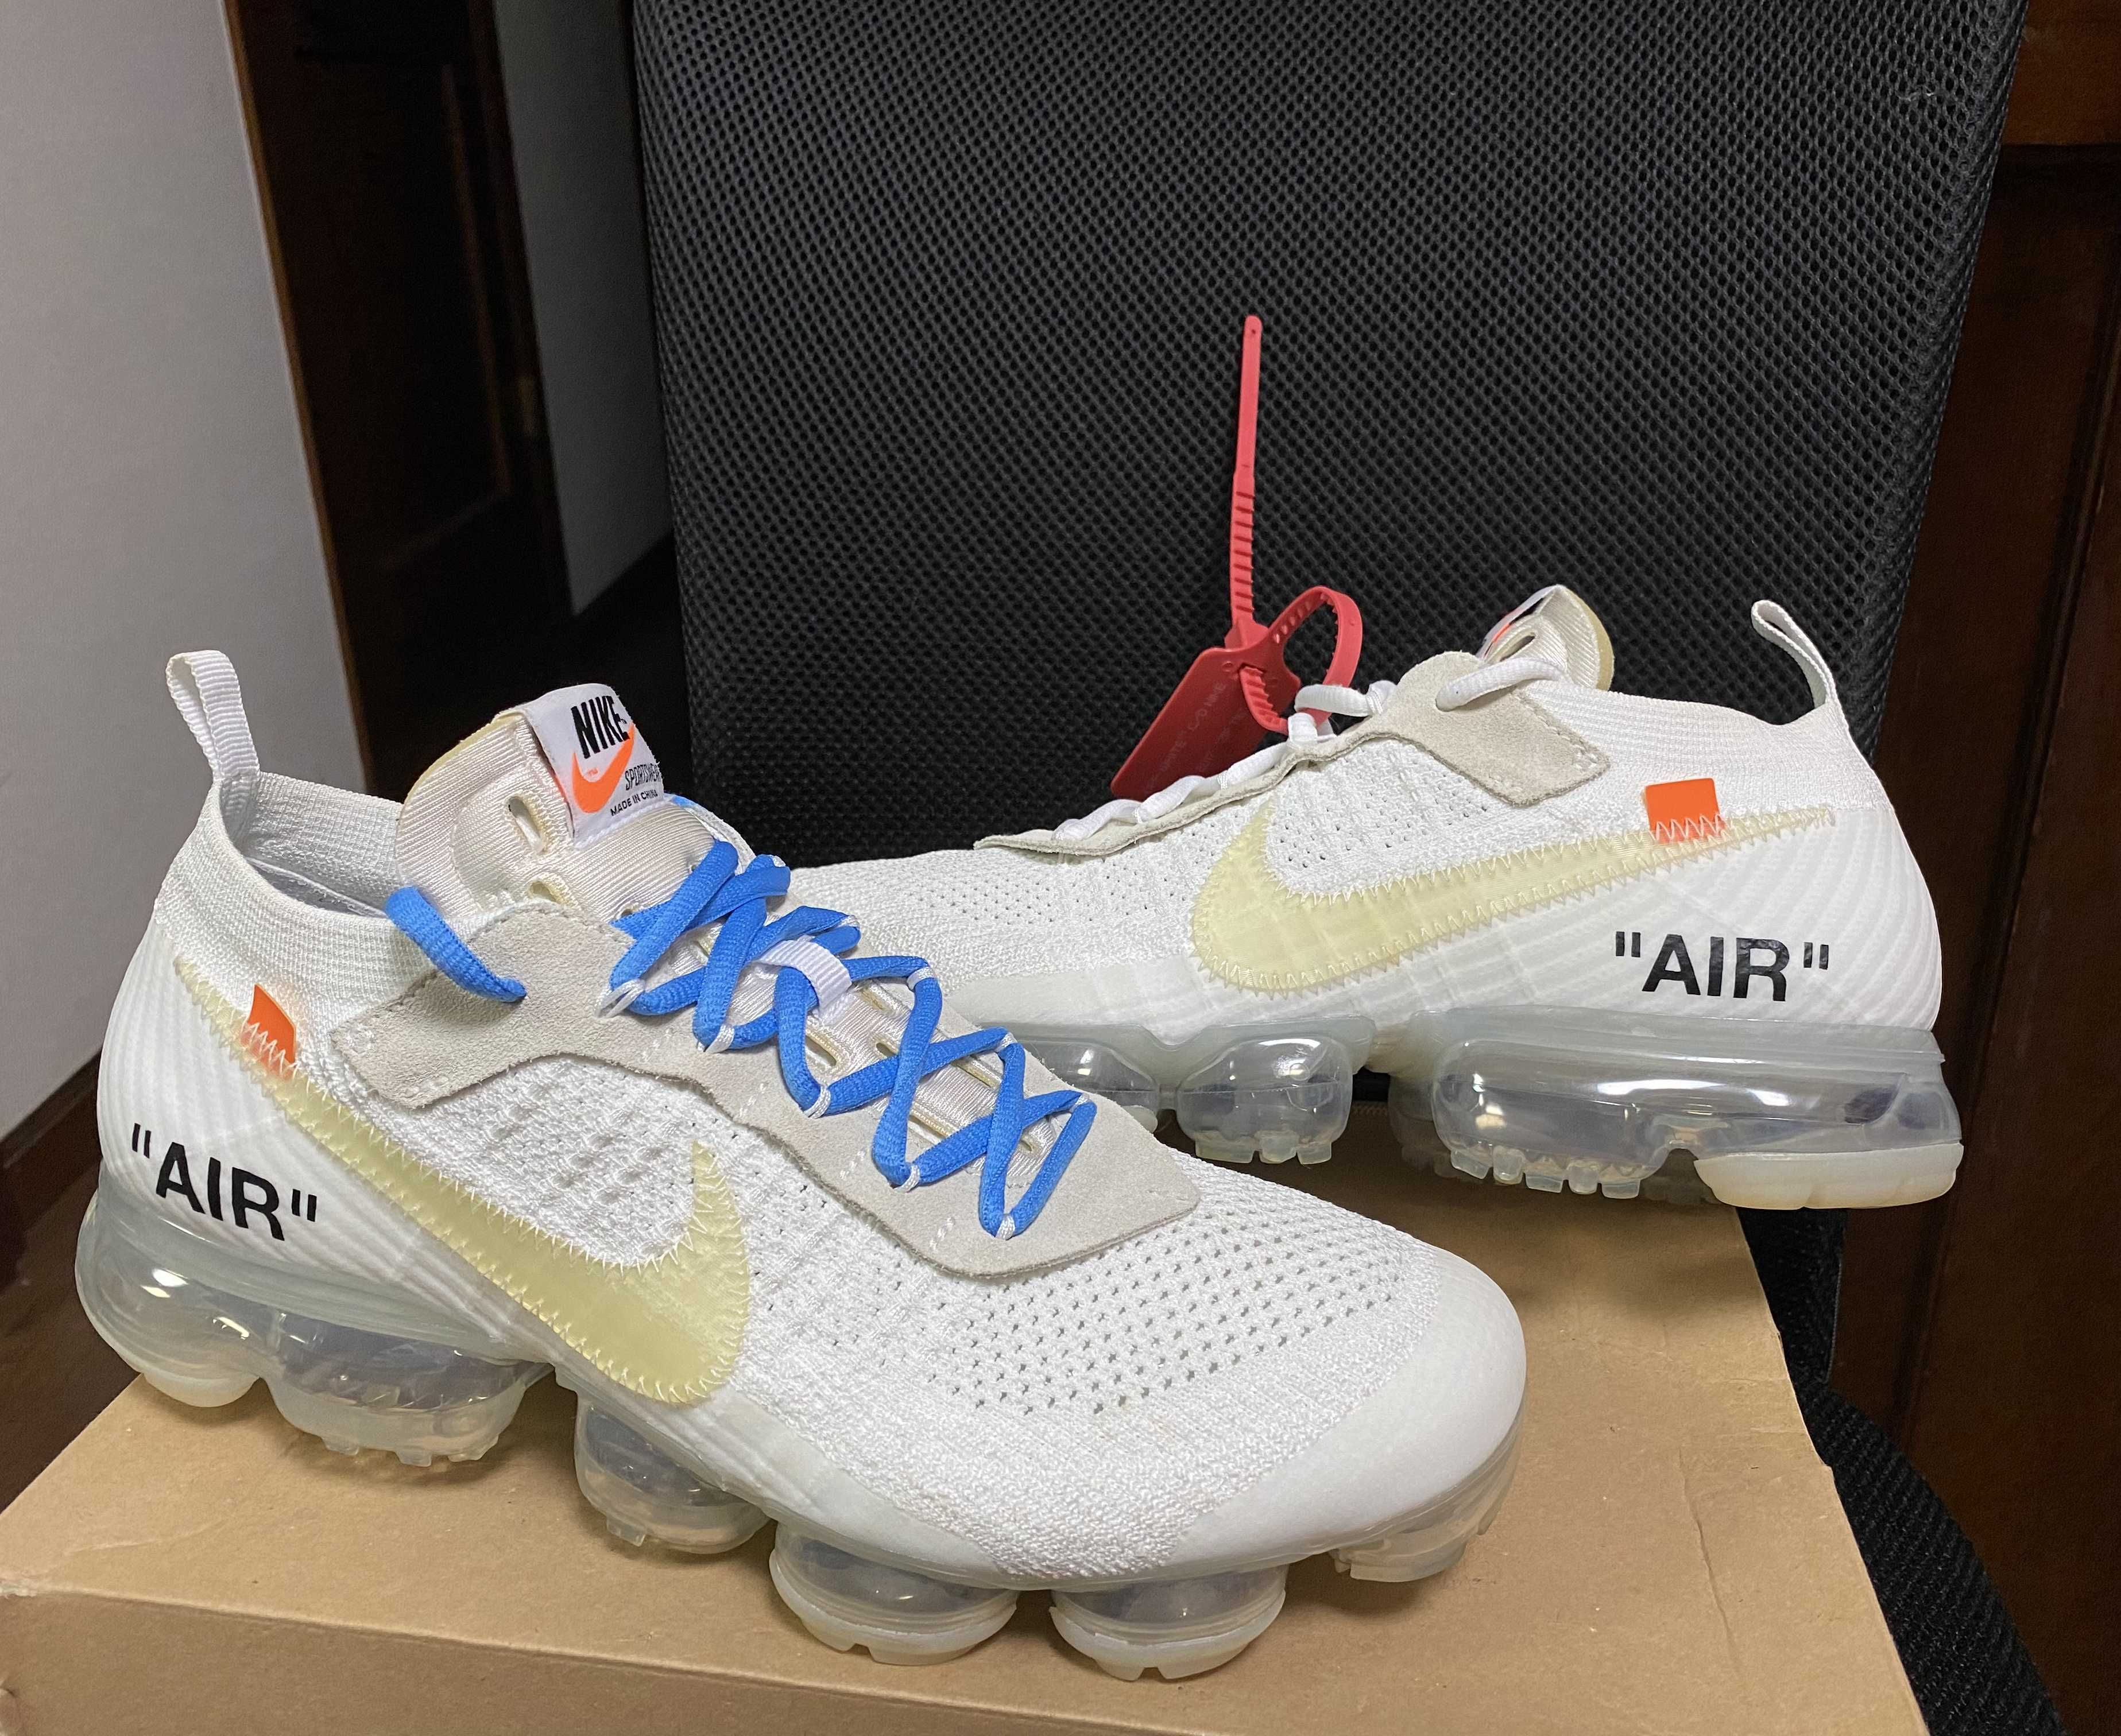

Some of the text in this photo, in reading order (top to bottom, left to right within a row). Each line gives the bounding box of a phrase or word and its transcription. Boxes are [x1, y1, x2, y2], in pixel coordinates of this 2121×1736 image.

[571, 695, 630, 759] NIKE
[610, 799, 632, 816] MADE
[632, 793, 641, 804] IN
[1615, 931, 1829, 1002] "AIR"
[132, 1122, 317, 1241] "AIR"
